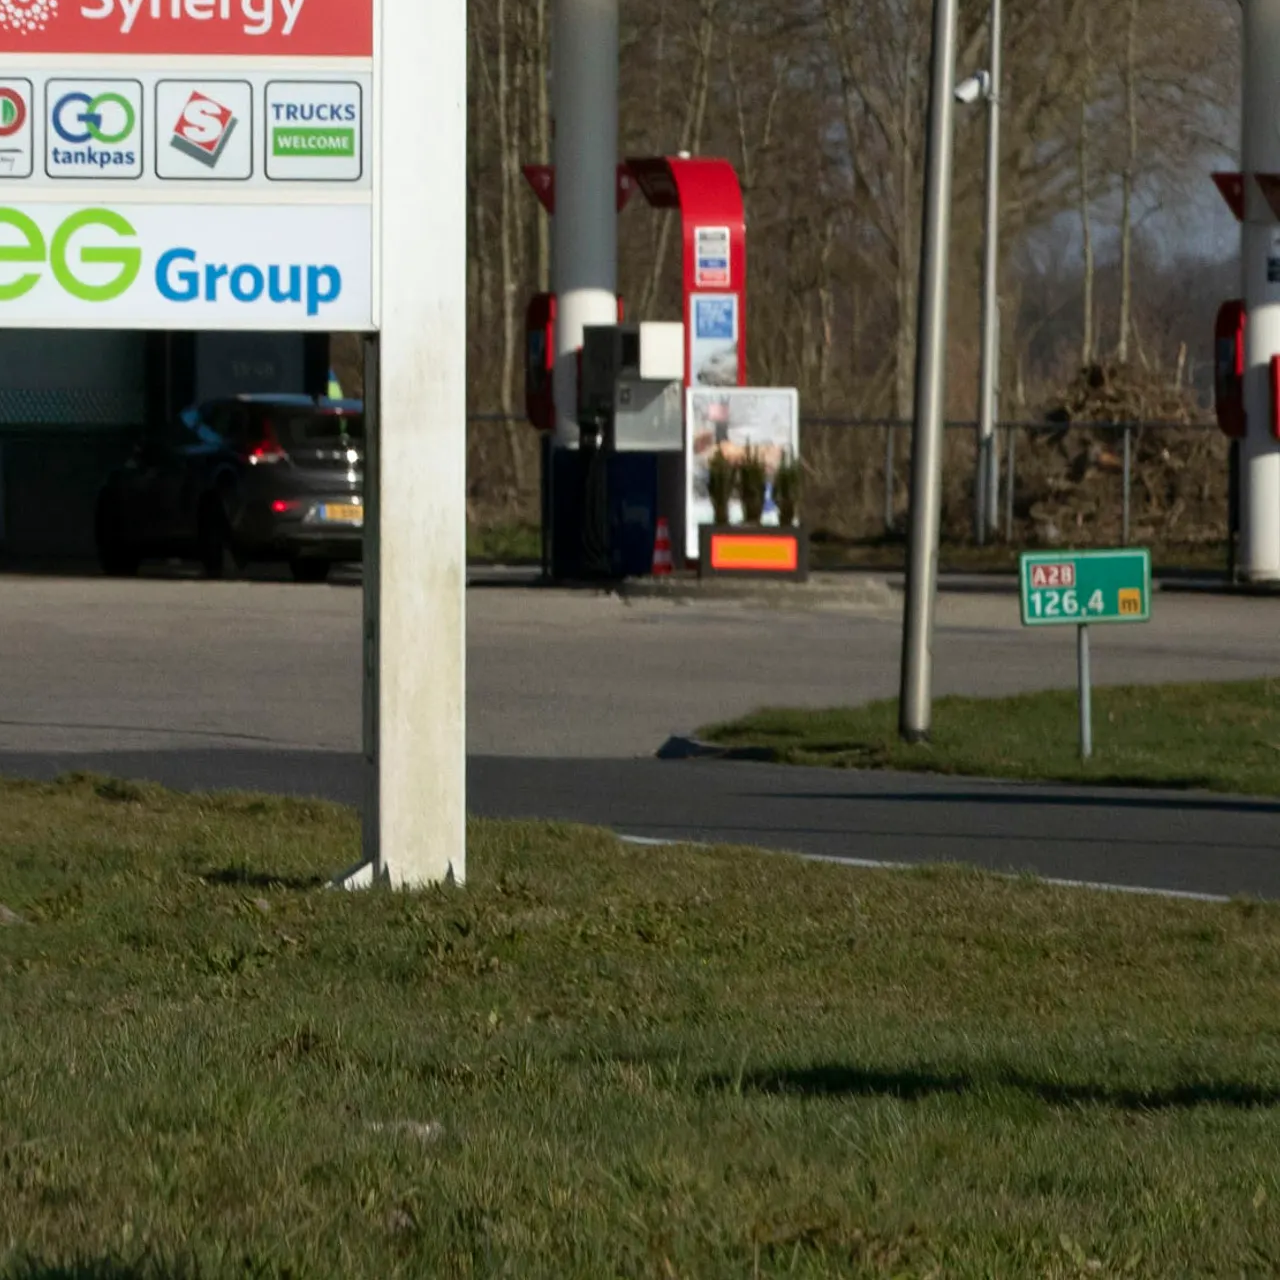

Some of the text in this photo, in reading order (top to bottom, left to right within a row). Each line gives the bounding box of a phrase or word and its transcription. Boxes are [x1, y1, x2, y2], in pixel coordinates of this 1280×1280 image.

[52, 91, 136, 144] GO
[271, 102, 356, 121] TRUCKS
[276, 133, 350, 151] WELCOME
[51, 146, 136, 169] tankpas
[154, 246, 342, 316] Group
[1033, 565, 1073, 585] A28
